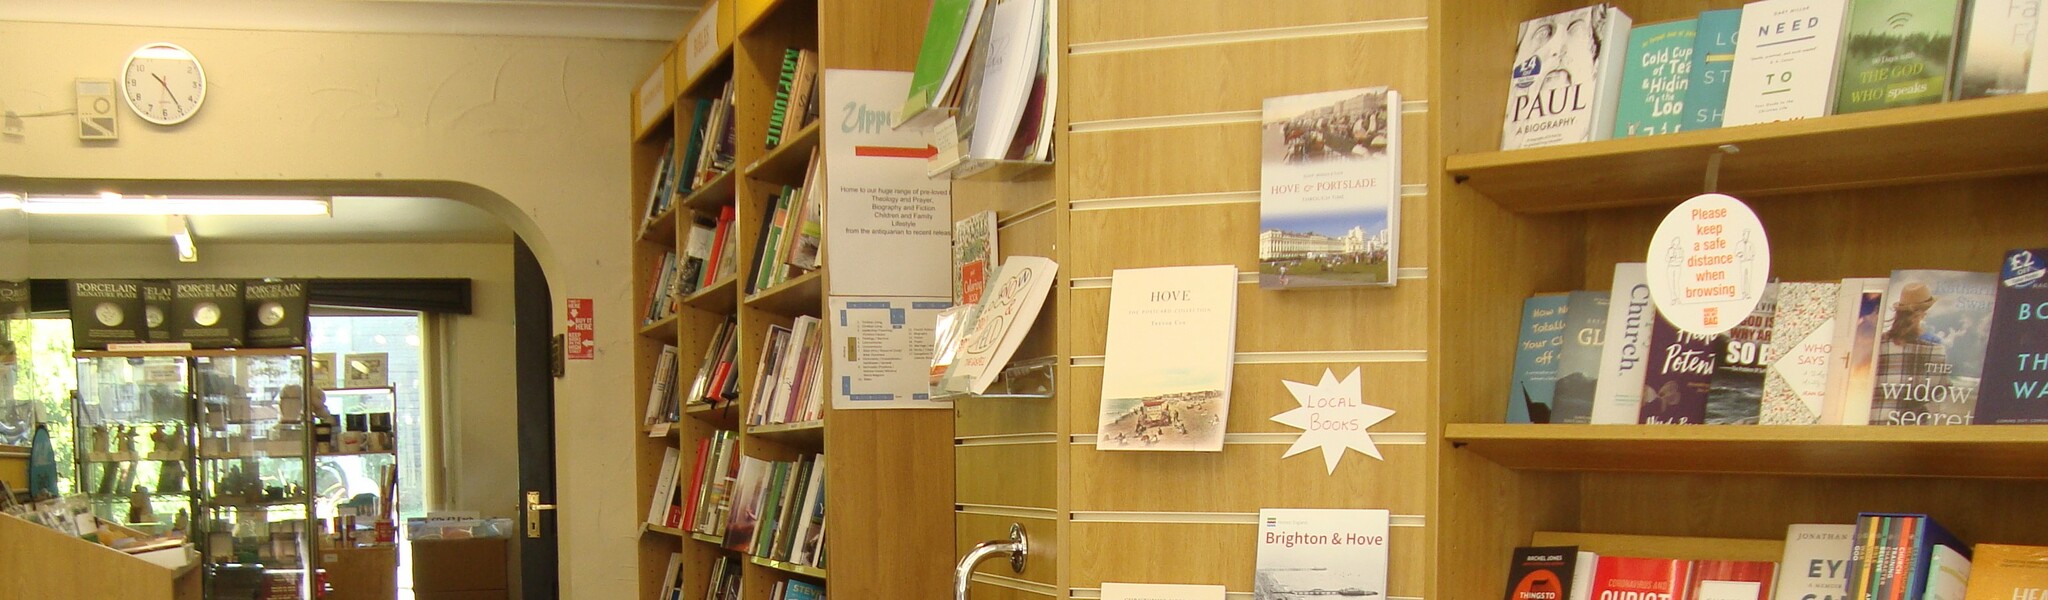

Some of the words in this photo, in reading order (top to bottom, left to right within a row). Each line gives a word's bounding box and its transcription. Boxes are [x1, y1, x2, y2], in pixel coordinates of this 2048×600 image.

[1758, 16, 1819, 37] NEED
[1642, 47, 1669, 67] Cold
[1673, 46, 1693, 61] Cup
[136, 64, 145, 72] 10
[188, 66, 192, 74] 2
[1652, 64, 1664, 76] of
[1860, 68, 1889, 84] THE
[1891, 62, 1924, 77] GOD
[1766, 71, 1792, 85] TO
[765, 48, 800, 145] KRYPTONITE
[1662, 91, 1674, 100] the
[1852, 88, 1883, 104] WHO
[1888, 81, 1928, 99] speaks
[148, 104, 153, 112] 7
[1512, 82, 1587, 122] PAUL
[1652, 96, 1684, 118] Loo
[162, 108, 168, 116] 6
[1515, 126, 1523, 136] A
[1524, 116, 1576, 134] BIOGRAPHY
[878, 187, 892, 195] huge
[1271, 184, 1300, 194] HOVE
[1304, 184, 1314, 192] &
[1316, 178, 1377, 191] PORTSLADE
[872, 204, 901, 212] Biography
[1692, 208, 1727, 220] Please
[872, 228, 904, 236] antiquarian
[1696, 224, 1723, 236] keep
[1694, 244, 1700, 252] a
[1704, 237, 1726, 250] safe
[1688, 253, 1734, 268] distance
[2012, 250, 2035, 270] £2
[1696, 270, 1725, 282] when
[76, 282, 136, 293] PORCELAIN
[177, 284, 238, 292] PORCELAIN
[246, 283, 301, 294] PORCELAIN
[1686, 284, 1736, 298] browsing
[1150, 290, 1191, 302] HOVE
[1532, 308, 1554, 318] How
[1704, 316, 1718, 326] BAG
[1619, 283, 1650, 376] Church.
[1730, 328, 1755, 340] WHY
[1523, 339, 1547, 350] Your
[1804, 344, 1832, 354] WHO
[1536, 351, 1553, 364] off
[1726, 340, 1756, 365] SO
[1798, 356, 1824, 366] SAYS
[1924, 362, 1952, 374] THE
[1881, 376, 1974, 404] widow
[1308, 394, 1357, 408] LOCAL
[1310, 412, 1358, 431] BOOKS
[1887, 409, 1974, 426] secret
[1266, 531, 1327, 548] Brighton
[1332, 532, 1342, 544] &
[1346, 533, 1382, 546] Hove
[1887, 546, 1898, 579] TRAINING
[1895, 547, 1905, 575] CHURCH
[1608, 578, 1651, 589] CORONAVIRUS
[1652, 580, 1668, 590] AND
[1520, 592, 1541, 600] THINGS
[1542, 592, 1556, 600] TO
